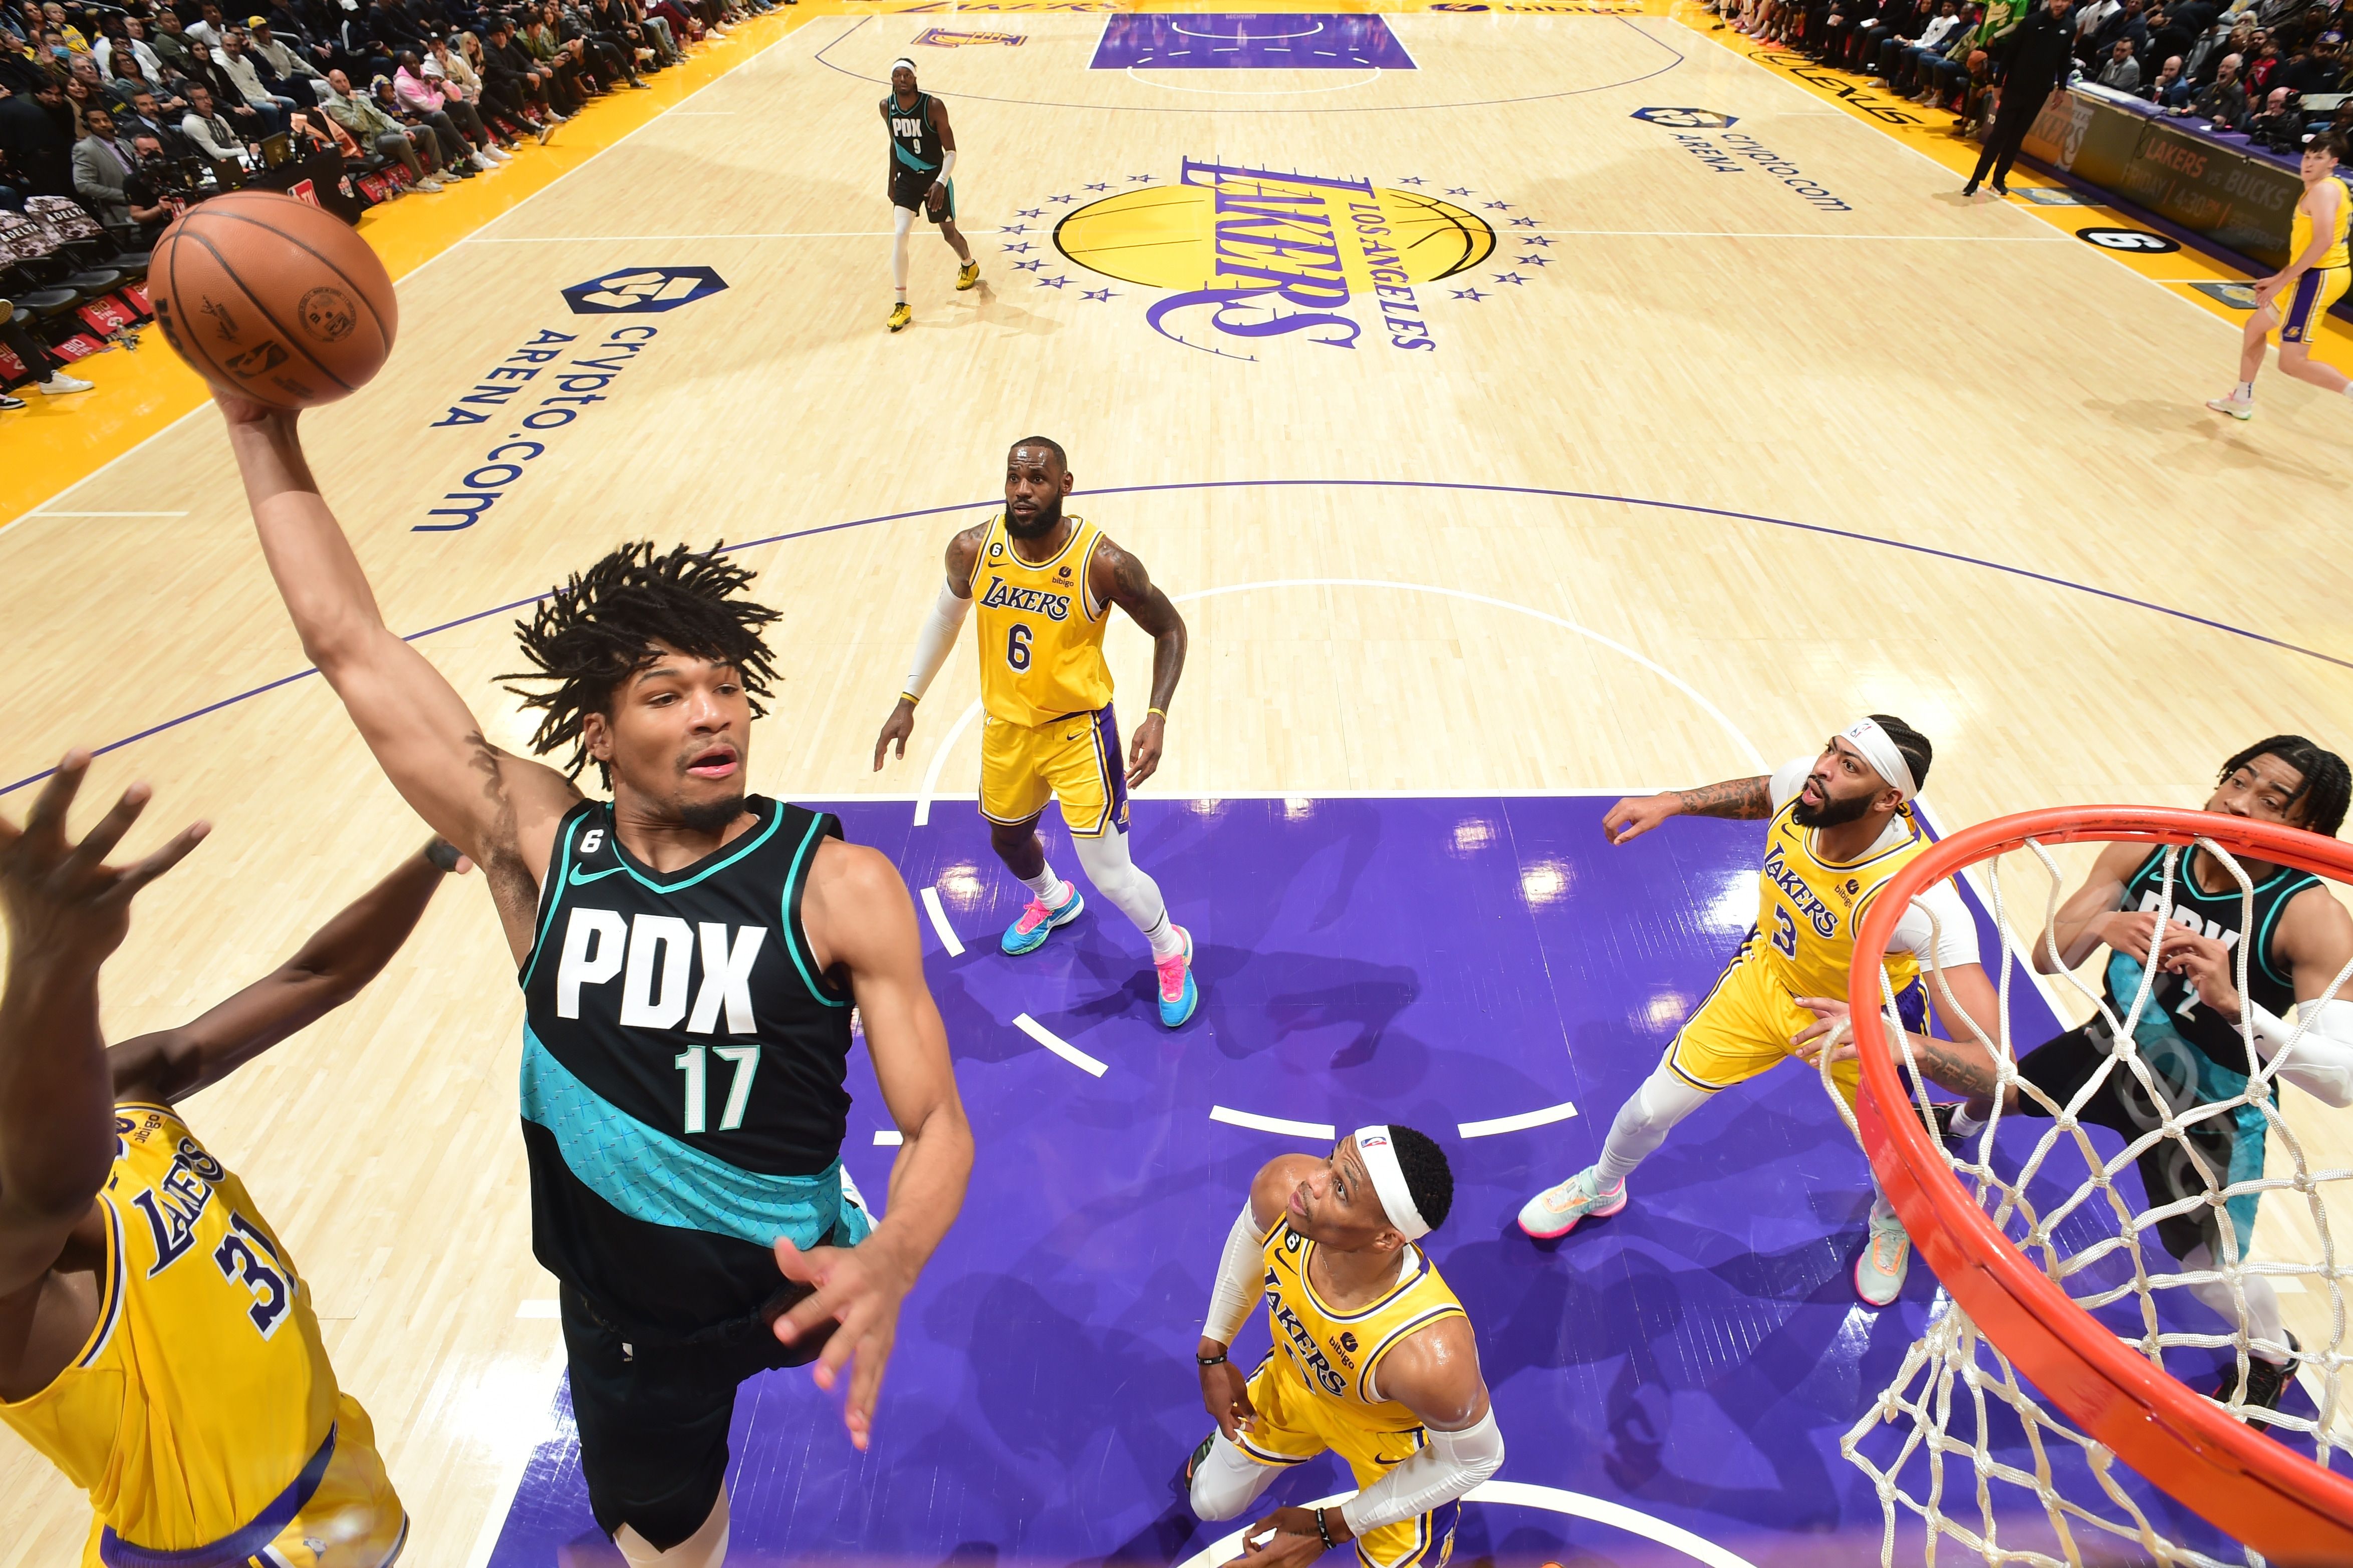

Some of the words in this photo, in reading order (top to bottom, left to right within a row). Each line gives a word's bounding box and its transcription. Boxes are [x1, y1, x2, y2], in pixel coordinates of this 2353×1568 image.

[1789, 68, 1925, 125] LEXUS
[892, 118, 923, 137] PDX
[913, 139, 921, 154] 9
[1669, 133, 1745, 173] ARENA
[1721, 134, 1853, 212] crypto.com
[2121, 162, 2168, 197] FRIDAY
[2145, 138, 2208, 178] LAKERS
[2224, 169, 2289, 210] BUCKS
[1348, 202, 1391, 236] LOS
[1146, 155, 1377, 362] LAKERS
[88, 300, 111, 316] BIO
[1360, 237, 1436, 352] ANGELES
[62, 339, 86, 352] BIO
[430, 329, 579, 428] ARENA
[410, 326, 658, 532] crypto.com
[980, 575, 1071, 622] LAKERS
[1052, 576, 1074, 588] bibigo
[1006, 623, 1034, 674] 6
[580, 829, 604, 853] 6
[1763, 840, 1839, 939] LAKERS
[1834, 884, 1853, 909] bibigo
[1770, 901, 1798, 961] 3
[557, 907, 768, 1034] PDX
[675, 1044, 760, 1133] 17
[1286, 1231, 1300, 1250] 6
[211, 1207, 301, 1343] 31
[1264, 1265, 1349, 1398] LAKERS
[1329, 1336, 1355, 1370] bibigo
